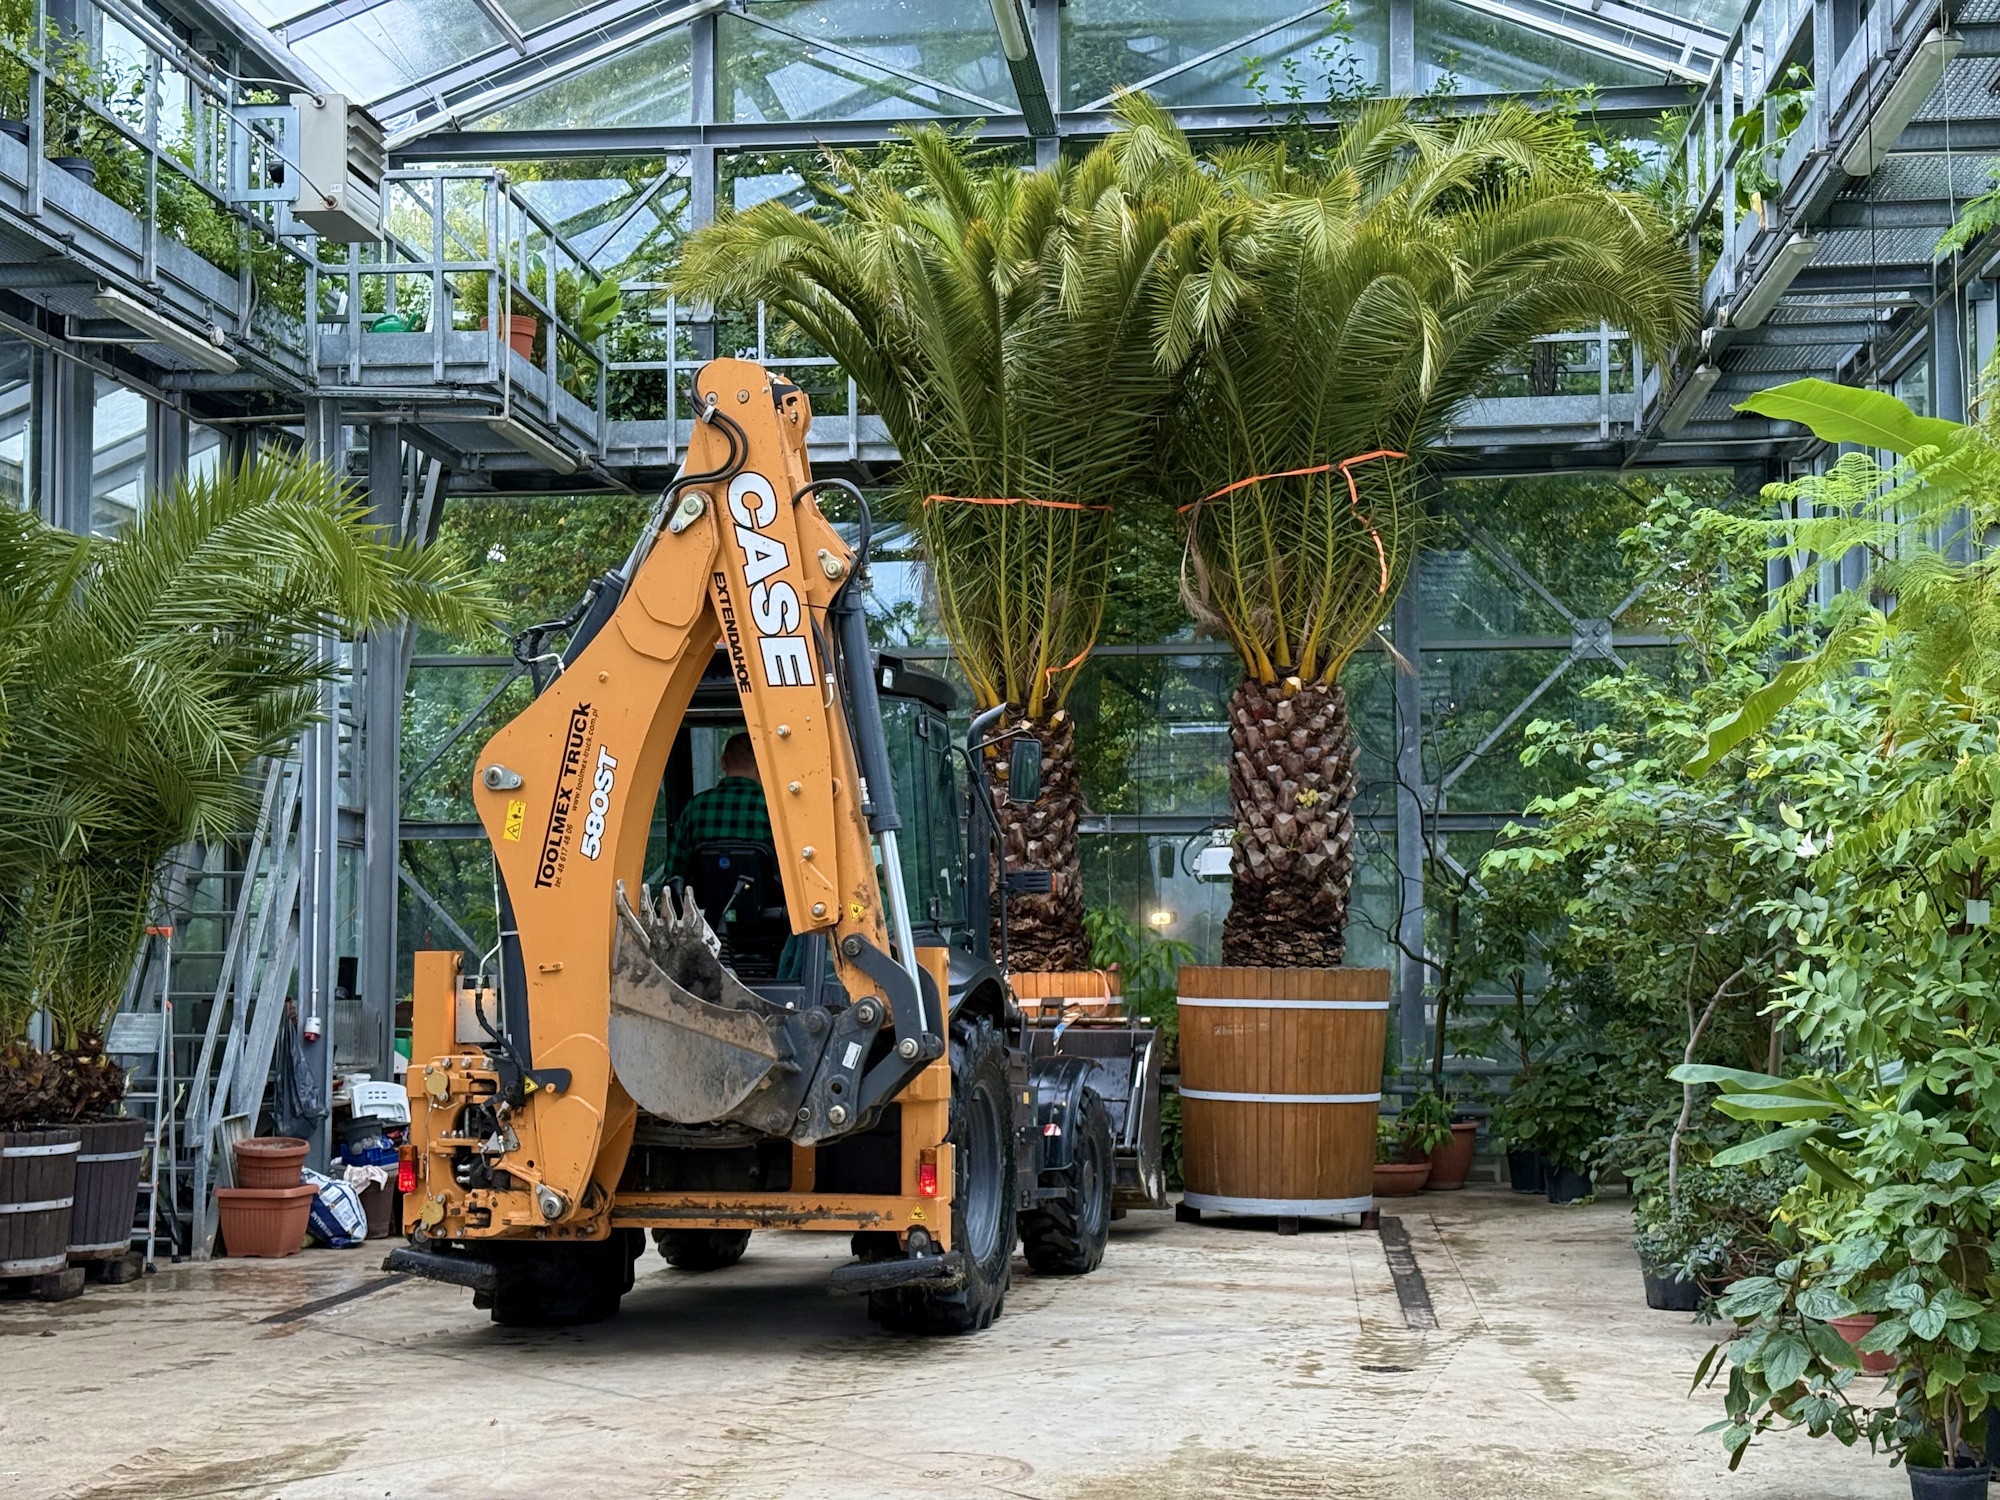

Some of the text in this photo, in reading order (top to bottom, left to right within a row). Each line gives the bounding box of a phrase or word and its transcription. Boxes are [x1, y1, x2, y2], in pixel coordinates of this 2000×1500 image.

[714, 572, 752, 693] EXTENDAHOE
[727, 471, 816, 687] CASE
[534, 701, 591, 889] TOOLMEX TRUCK
[554, 708, 599, 888] tel. 48 617 48 06 www.toolmex-truck.com.pl
[580, 744, 618, 861] 580ST
